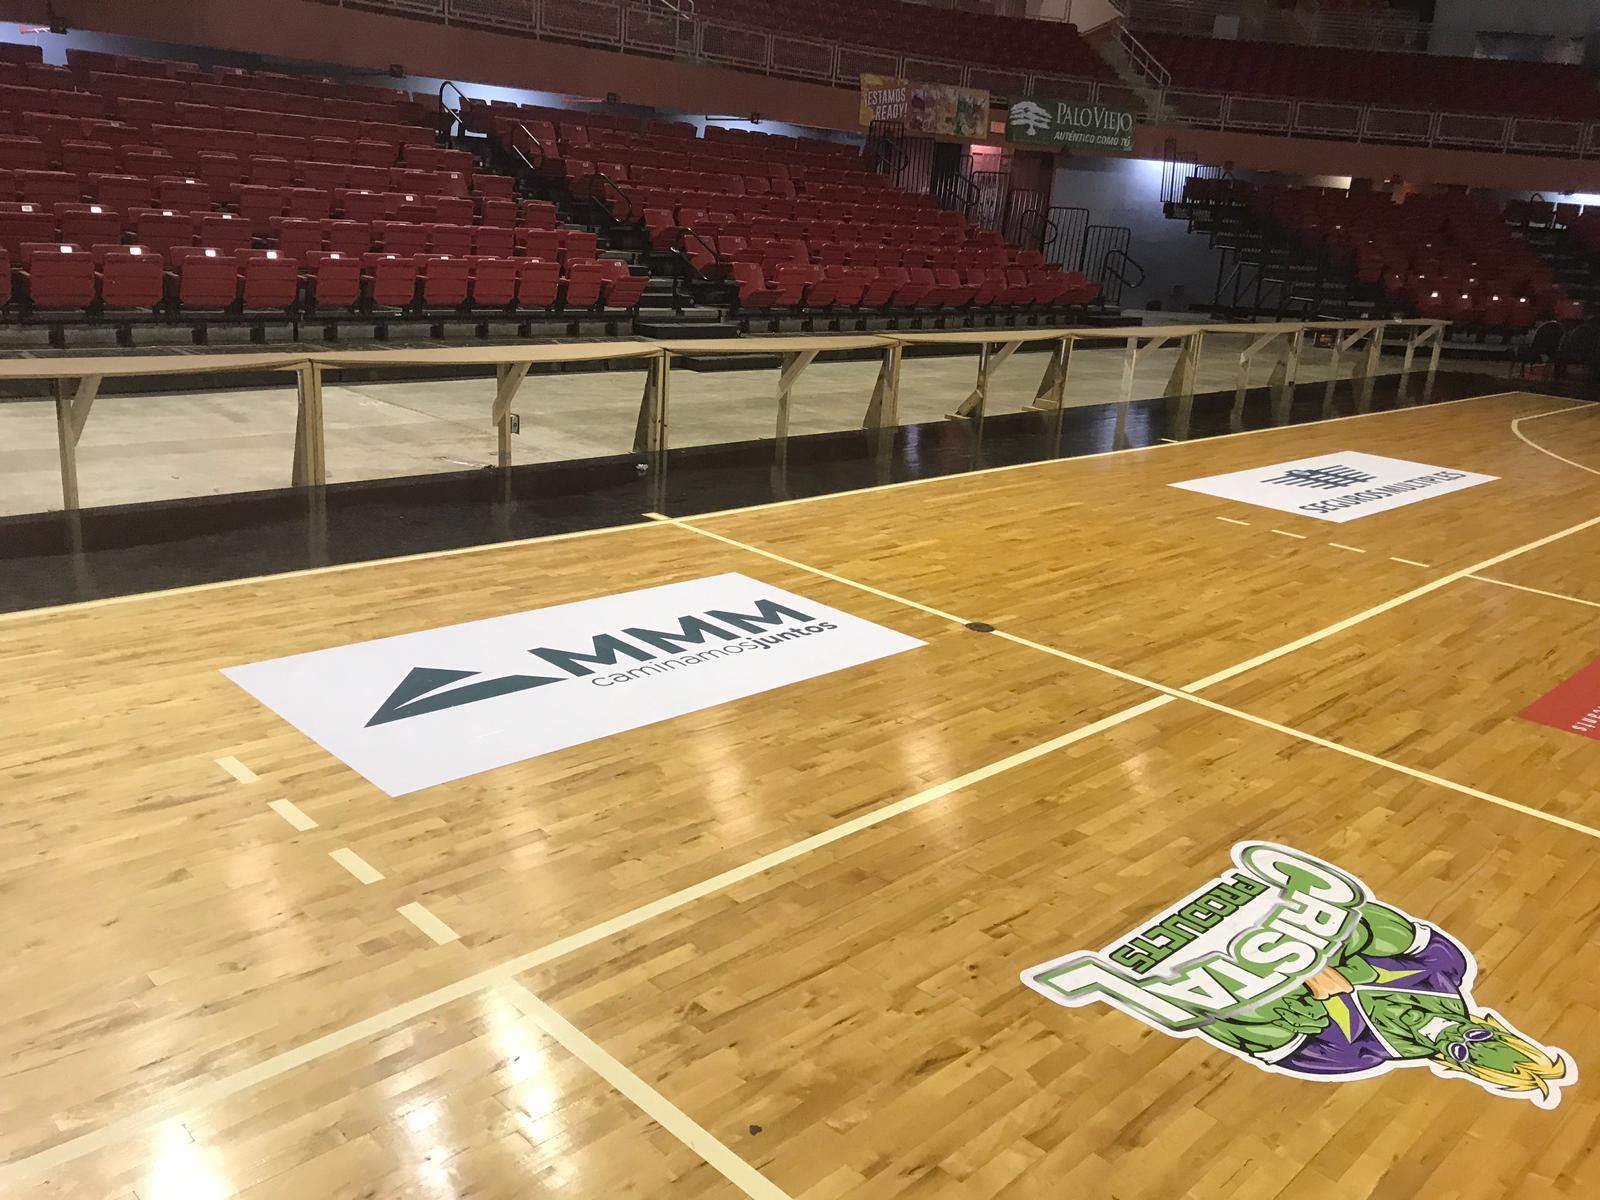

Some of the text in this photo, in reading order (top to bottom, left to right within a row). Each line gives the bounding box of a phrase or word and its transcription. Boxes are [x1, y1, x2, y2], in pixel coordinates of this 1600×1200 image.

[875, 103, 908, 121] READY!
[1096, 135, 1119, 146] COMO
[1120, 136, 1131, 147] TÚ
[529, 599, 816, 677] MMM
[1034, 844, 1365, 1030] CRISTAL
[1108, 872, 1270, 976] PRODUCTS
